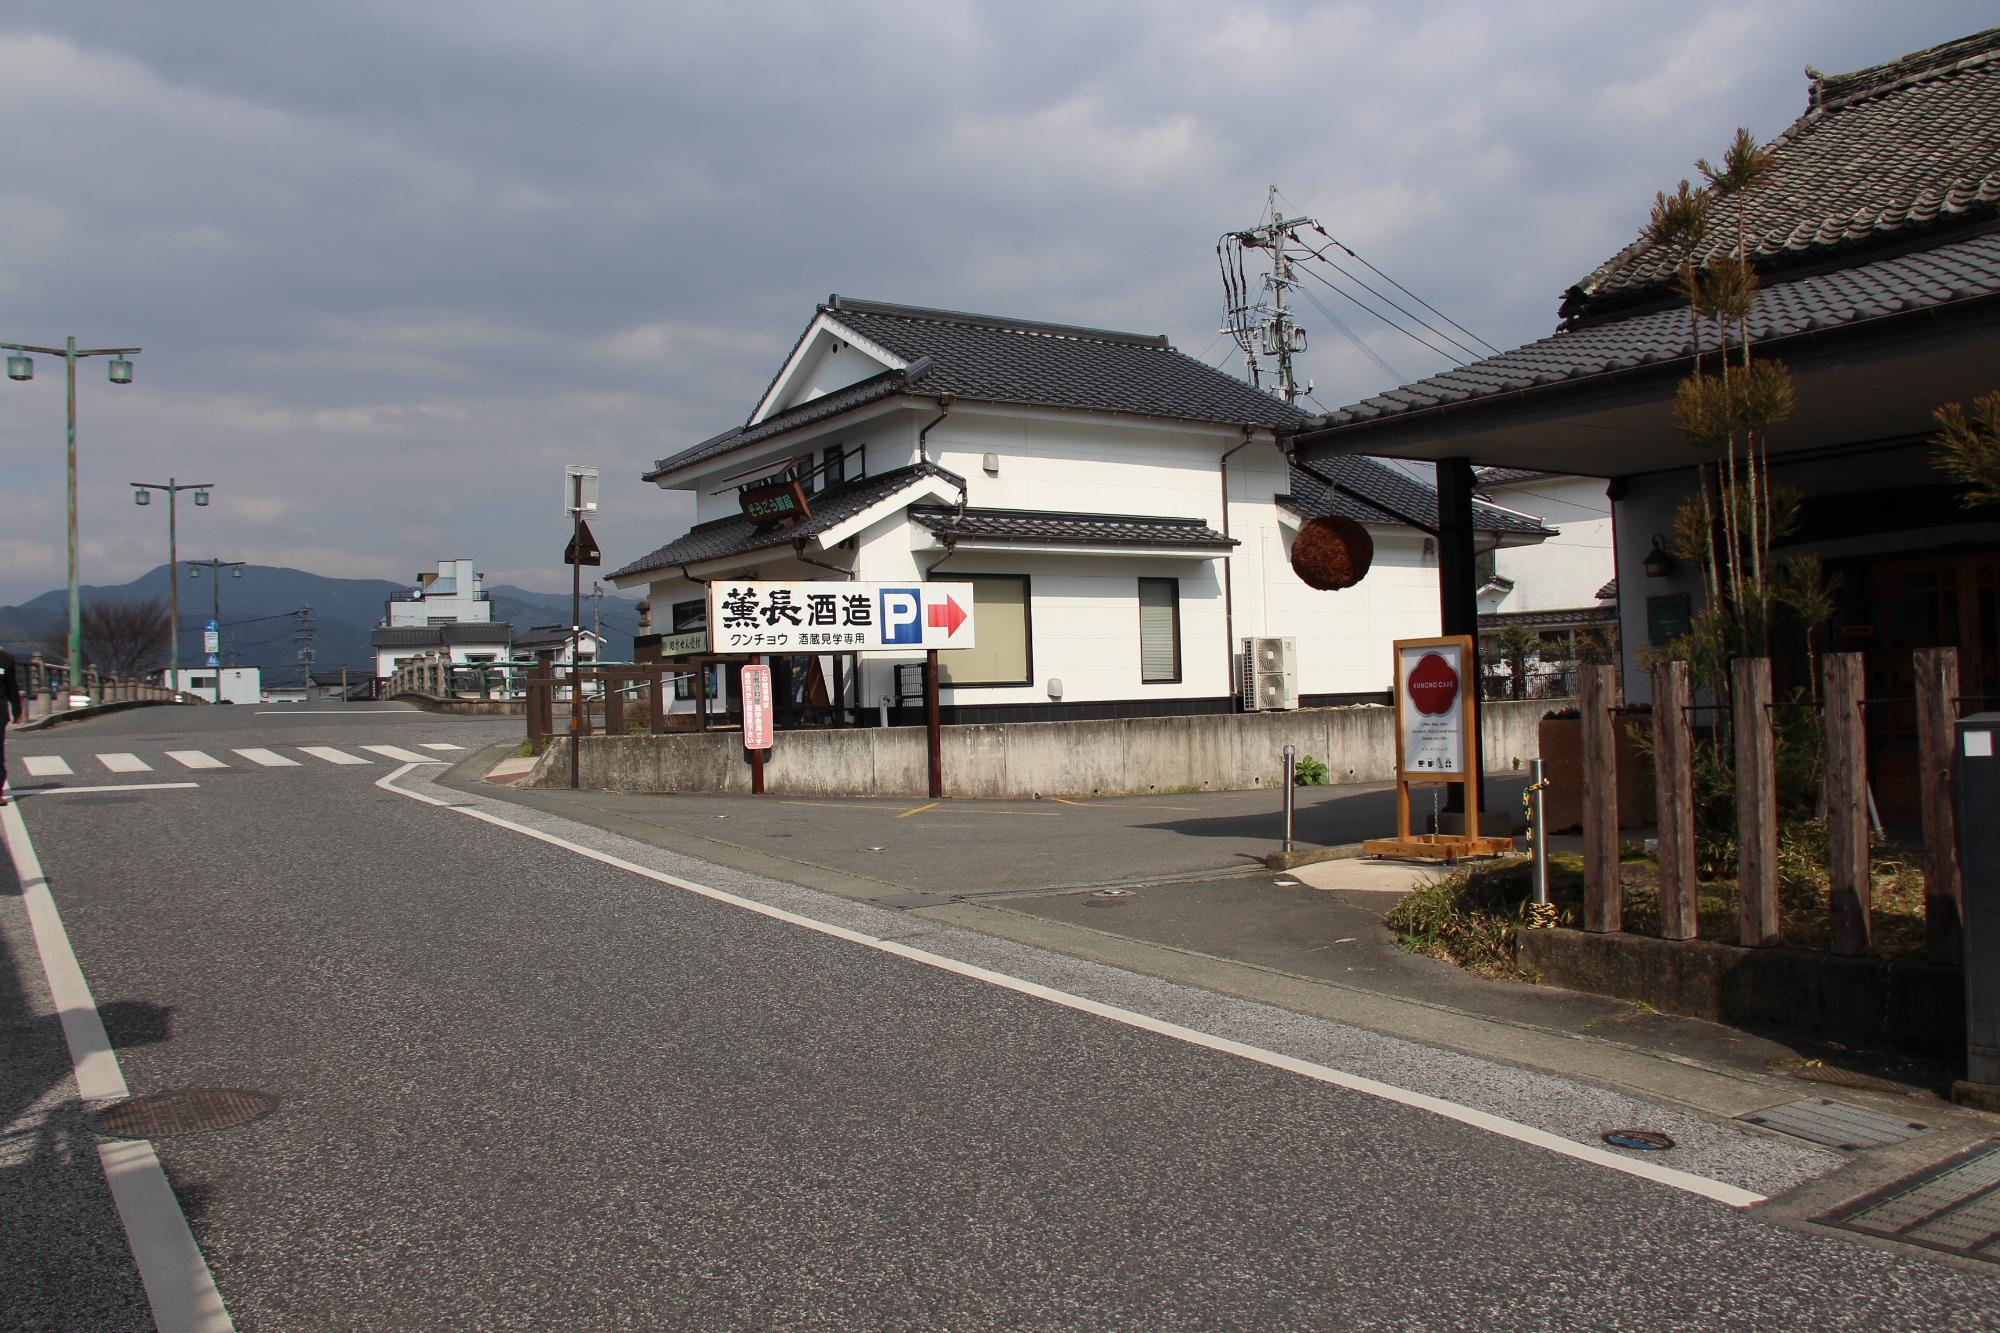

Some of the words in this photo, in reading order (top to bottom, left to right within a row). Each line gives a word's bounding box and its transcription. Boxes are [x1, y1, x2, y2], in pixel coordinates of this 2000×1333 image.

[748, 494, 794, 517] そうごう薬局
[721, 587, 873, 629] 薫長酒造
[884, 593, 917, 640] P
[730, 633, 788, 646] クンチョウ
[798, 633, 865, 645] 酒蔵見学専用
